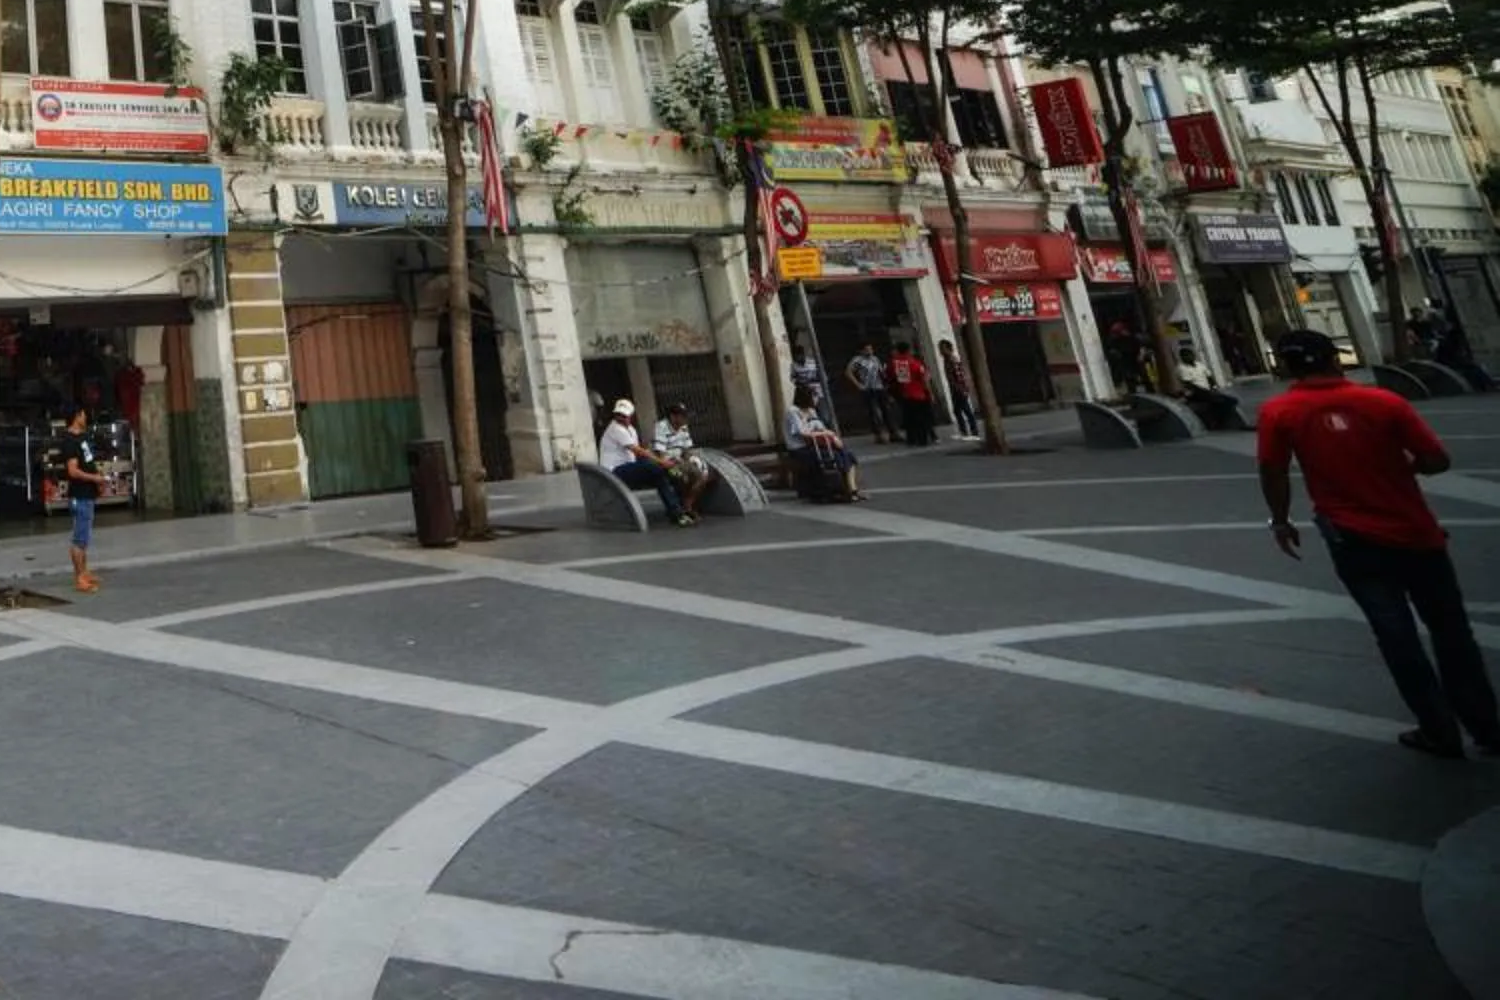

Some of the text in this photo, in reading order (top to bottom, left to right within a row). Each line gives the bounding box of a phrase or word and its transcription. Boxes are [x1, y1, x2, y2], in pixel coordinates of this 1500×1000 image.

[0, 178, 118, 200] BREAKFIELD
[346, 185, 407, 208] KOLEJ
[63, 203, 123, 218] FANCY
[133, 204, 183, 219] SHOP
